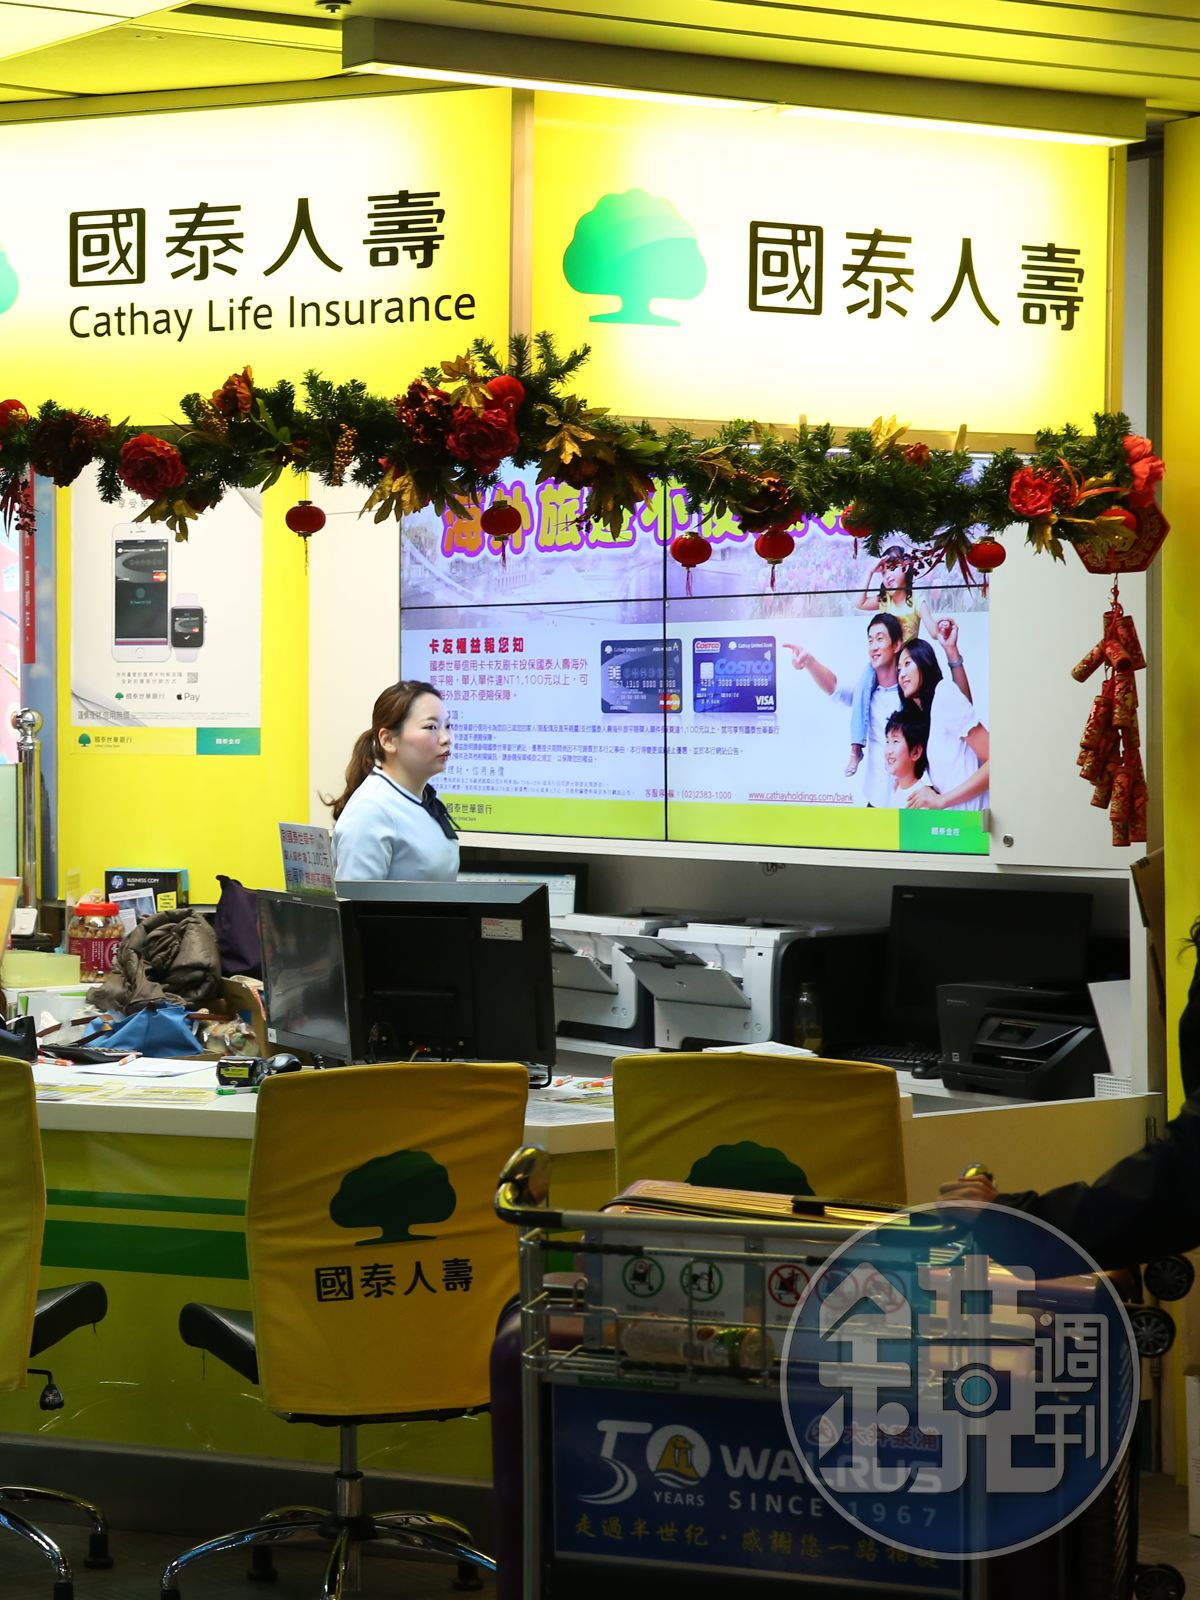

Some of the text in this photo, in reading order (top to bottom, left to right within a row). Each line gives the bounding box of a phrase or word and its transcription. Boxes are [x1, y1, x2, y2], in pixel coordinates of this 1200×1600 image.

[69, 189, 445, 288] 國泰人壽
[748, 220, 1085, 331] 國泰人壽
[69, 292, 477, 343] Cathay Life Insurance
[184, 692, 201, 703] Pay
[755, 695, 775, 706] VISA
[111, 875, 123, 889] hp
[314, 1257, 474, 1302] 國泰人壽
[653, 1491, 705, 1507] YEARS
[728, 1489, 937, 1528] SINCE 1967
